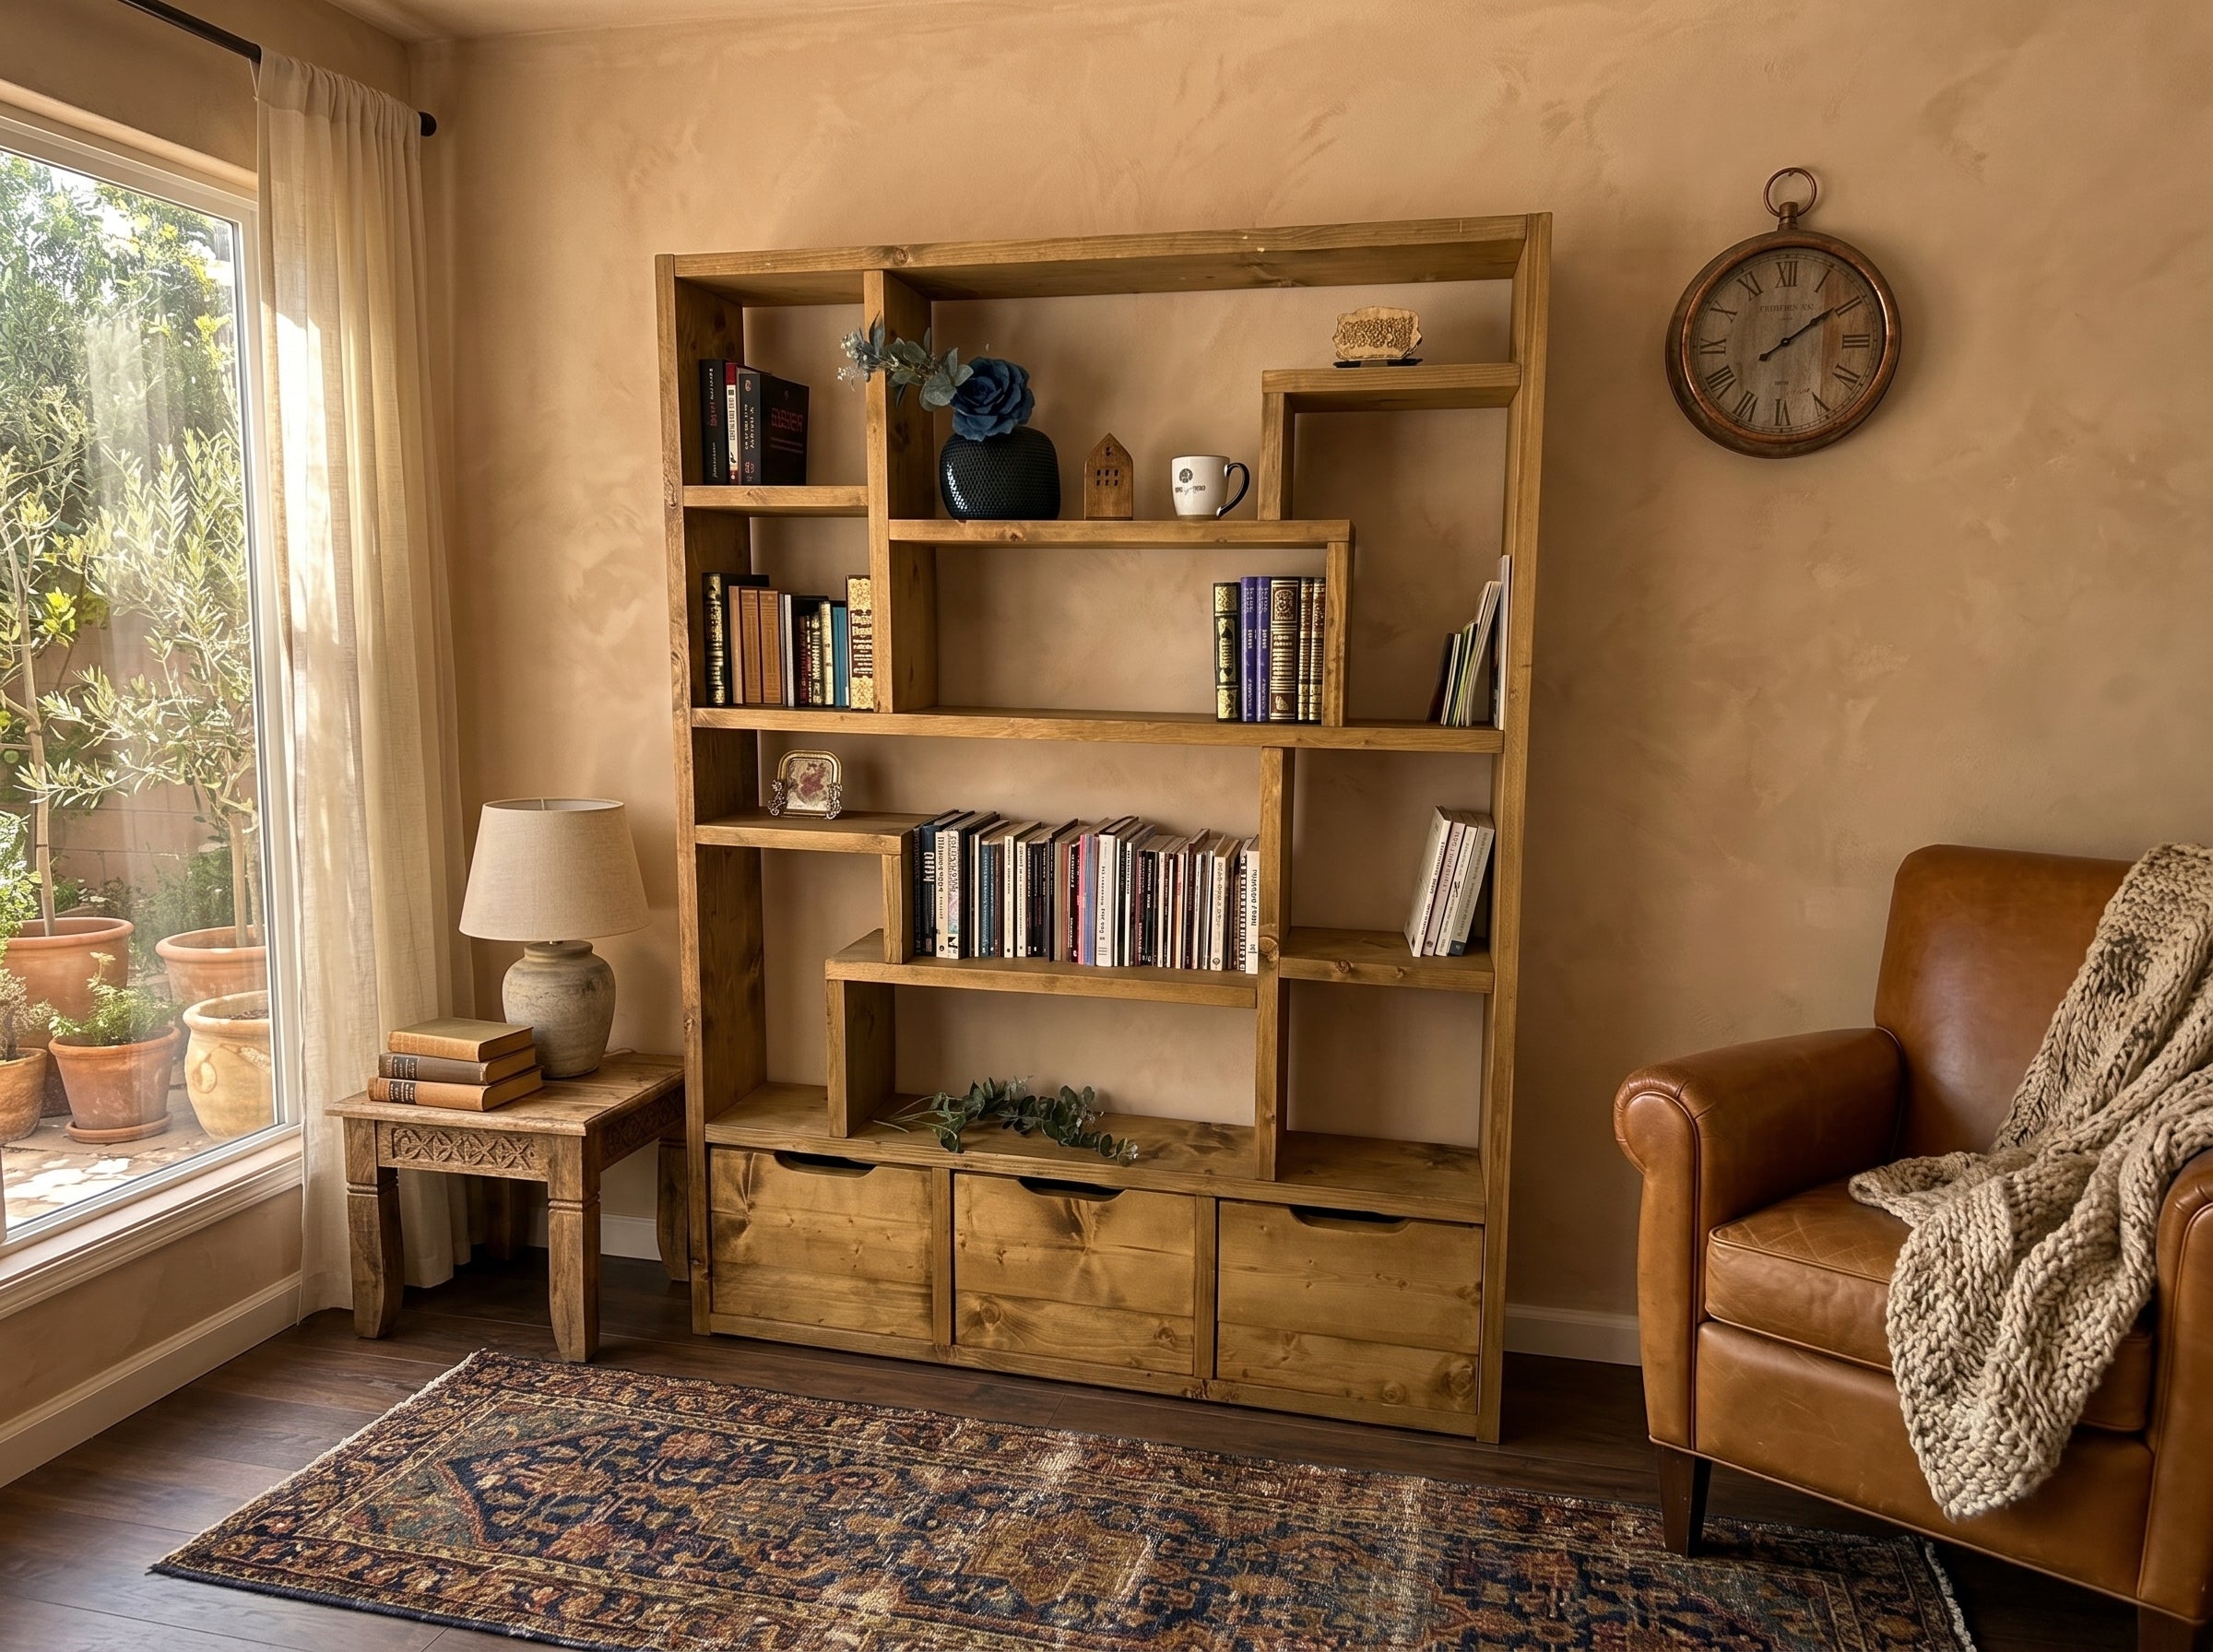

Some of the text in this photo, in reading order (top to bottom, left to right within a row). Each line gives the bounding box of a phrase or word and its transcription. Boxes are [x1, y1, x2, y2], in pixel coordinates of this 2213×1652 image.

[1775, 261, 1798, 288] XII
[1814, 268, 1832, 293] I
[1710, 300, 1738, 324] X
[1834, 295, 1864, 318] II
[1842, 333, 1871, 349] III
[1704, 363, 1737, 401] VIII
[1811, 392, 1831, 419] V
